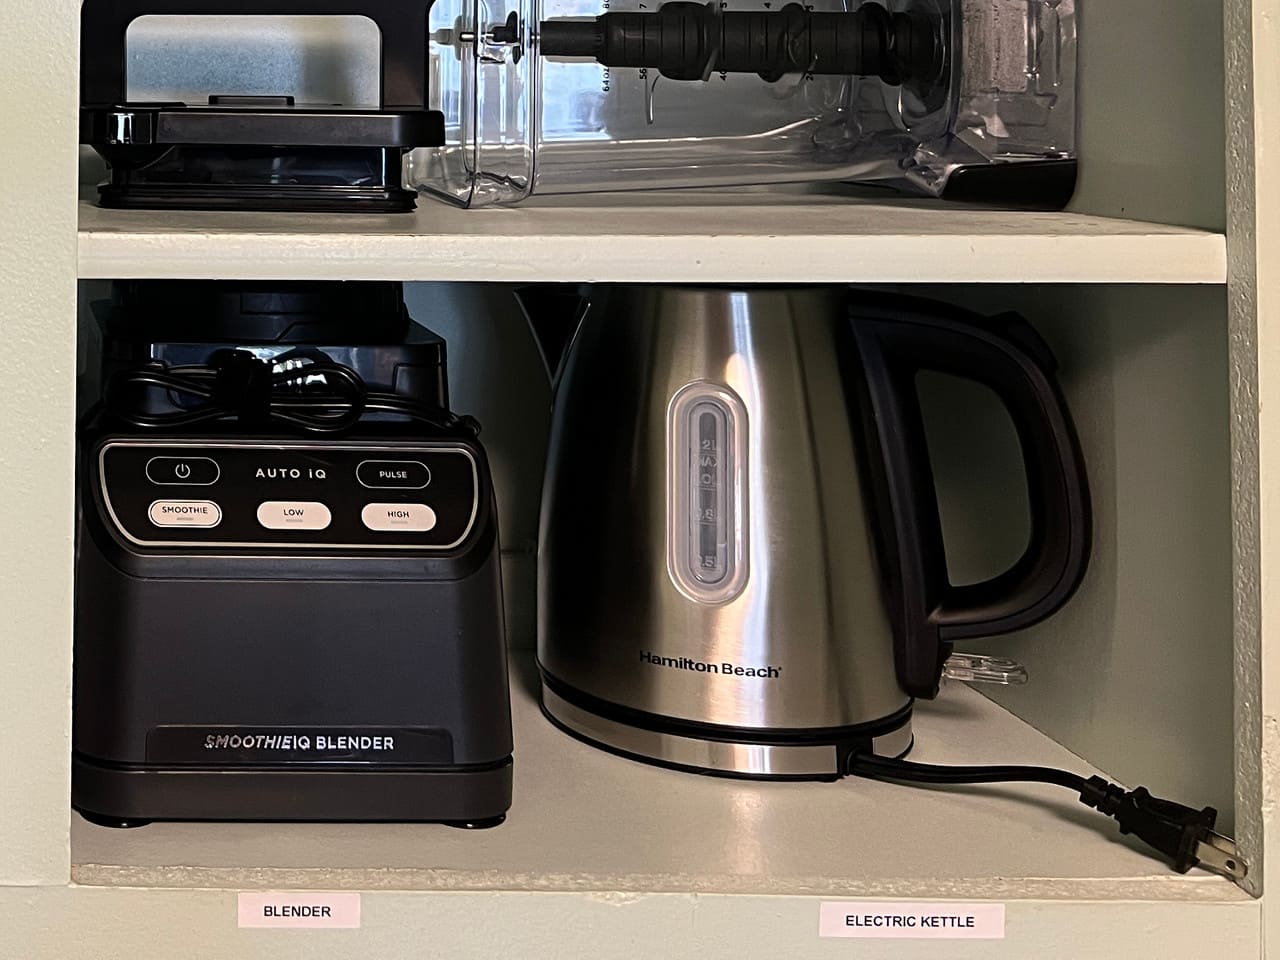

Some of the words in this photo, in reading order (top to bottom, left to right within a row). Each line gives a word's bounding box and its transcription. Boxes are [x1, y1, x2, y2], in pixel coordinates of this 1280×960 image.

[255, 468, 301, 479] AUTO
[379, 470, 408, 479] PULSE
[161, 505, 209, 515] SMOOTHIE
[283, 508, 304, 517] LOW
[387, 510, 410, 518] HIGH
[639, 650, 718, 674] Hamilton
[721, 663, 780, 678] Beach
[316, 735, 394, 750] BLENDER
[263, 905, 332, 917] BLENDER
[845, 915, 916, 927] ELECTRIC
[920, 916, 975, 928] KETTLE
